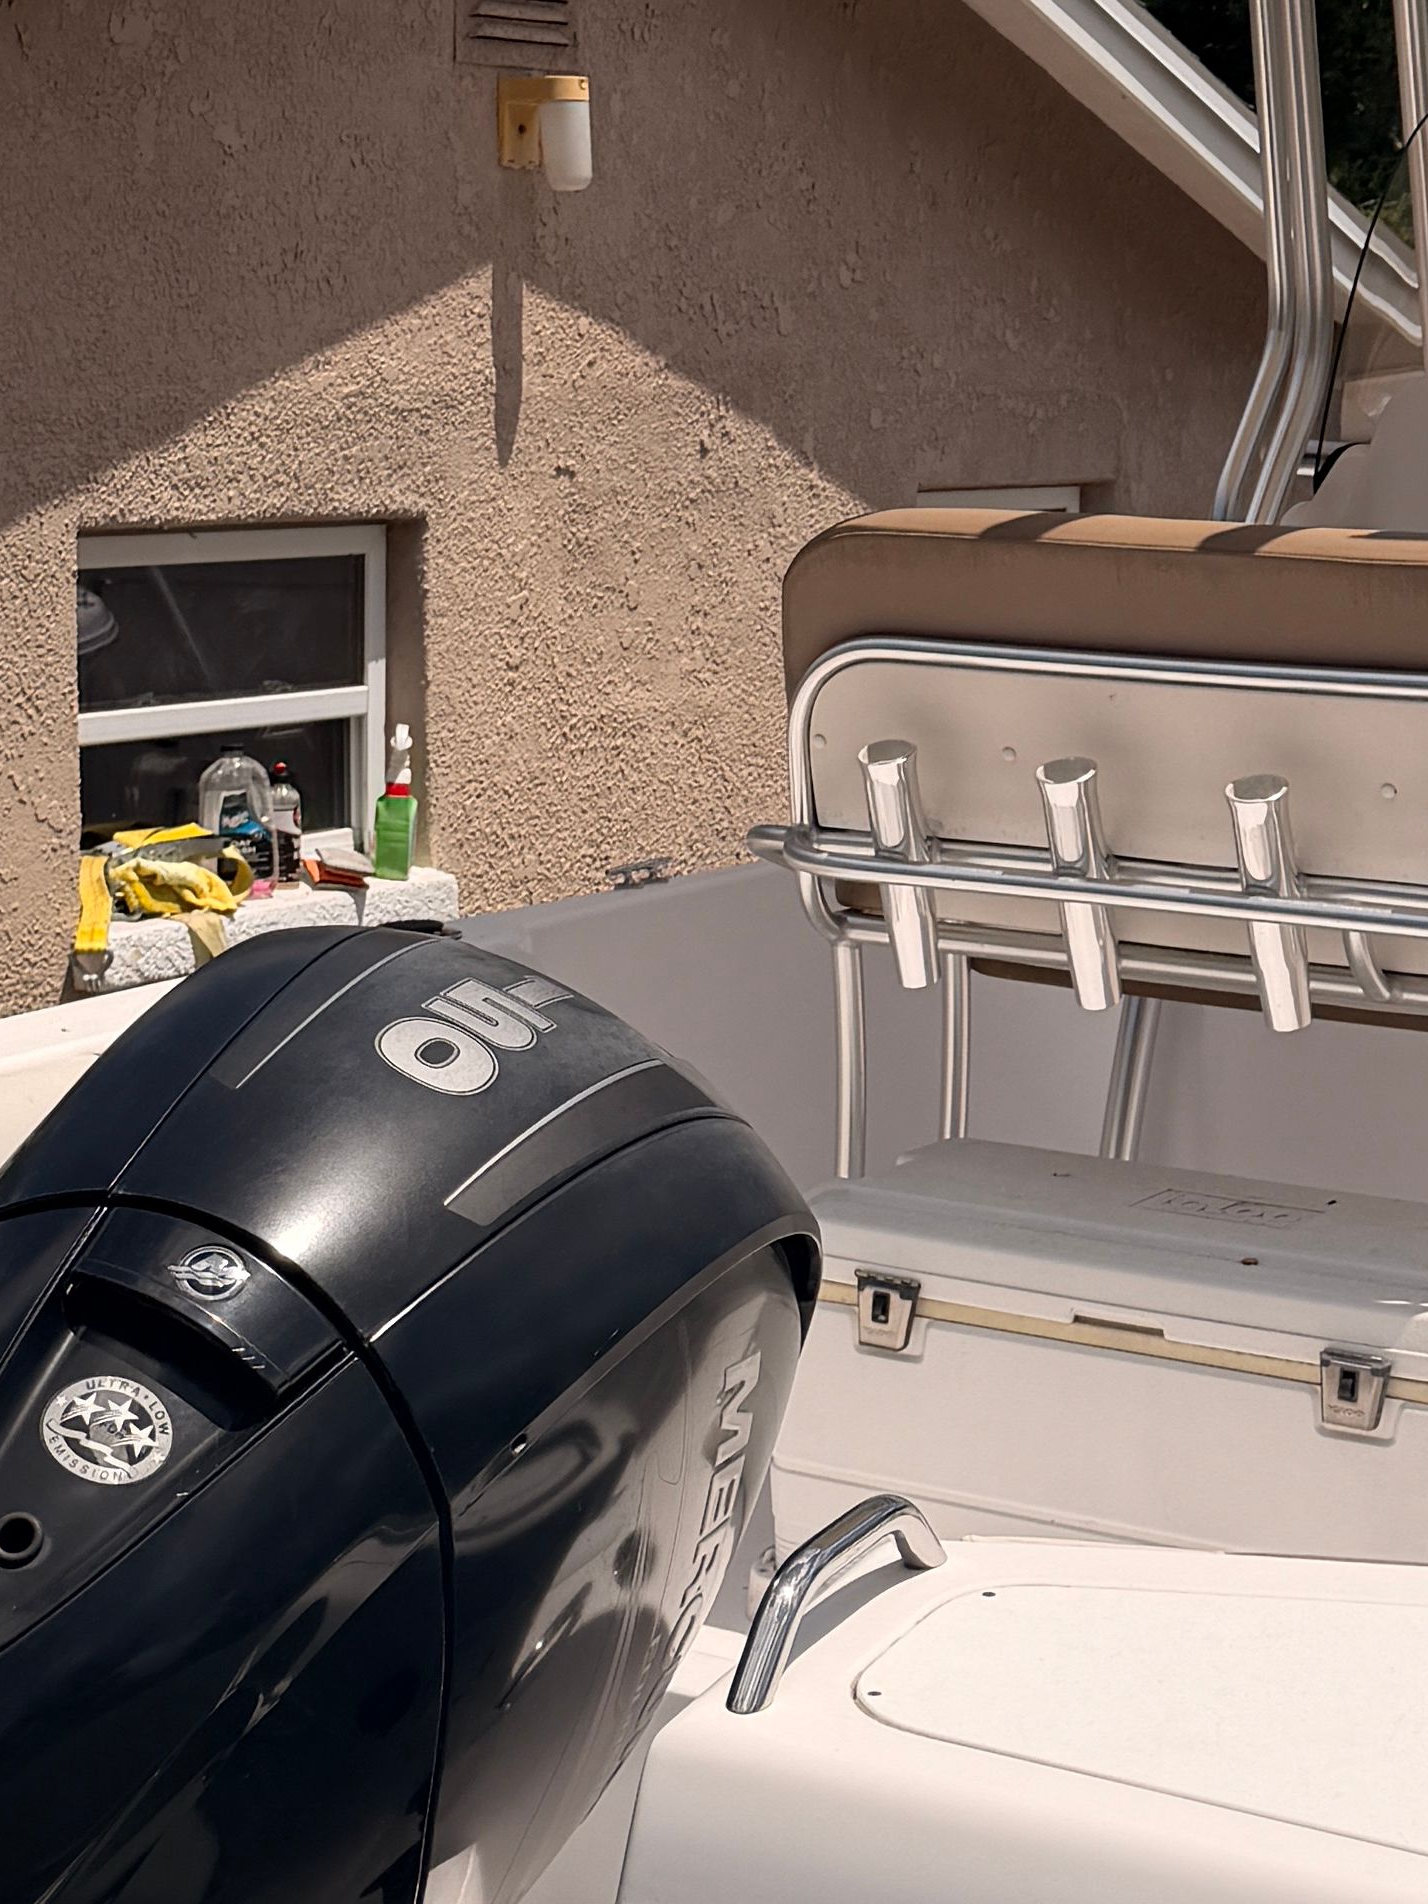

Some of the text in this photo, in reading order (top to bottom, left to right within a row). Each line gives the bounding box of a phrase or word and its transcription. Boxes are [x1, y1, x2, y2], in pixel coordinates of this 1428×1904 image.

[85, 1378, 141, 1398] ULTRA
[147, 1400, 170, 1436] LOW
[48, 1435, 123, 1482] EMISSION
